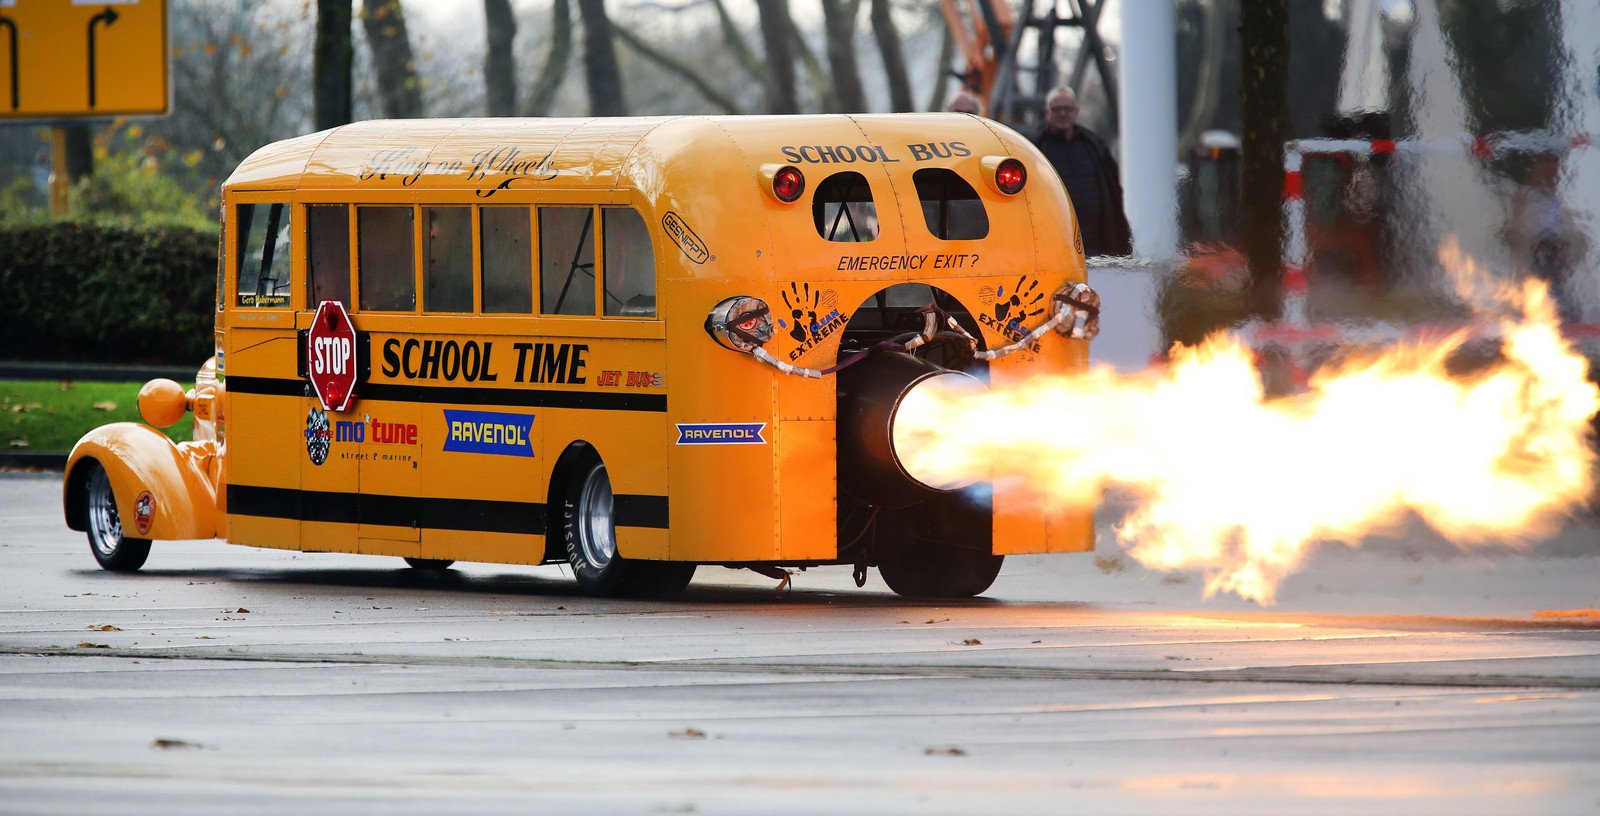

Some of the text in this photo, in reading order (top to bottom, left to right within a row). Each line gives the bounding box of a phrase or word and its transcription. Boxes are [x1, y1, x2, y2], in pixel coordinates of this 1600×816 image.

[781, 141, 972, 164] SCHOOL BUS
[434, 159, 463, 176] on
[466, 145, 560, 198] Wheels
[664, 214, 706, 259] GESNIPPT
[837, 255, 928, 271] EMERGENCY
[811, 308, 840, 333] CLEAN
[978, 313, 1041, 354] EXTREE
[789, 312, 849, 362] EXTREME
[314, 336, 351, 375] STOP
[381, 338, 589, 384] SCHOOL TIME
[597, 370, 650, 387] JET BUS
[452, 421, 526, 445] RAVENOL
[685, 429, 754, 439] RAVENOL
[341, 452, 368, 461] street
[382, 454, 412, 462] marine
[564, 500, 586, 576] Hoosier
